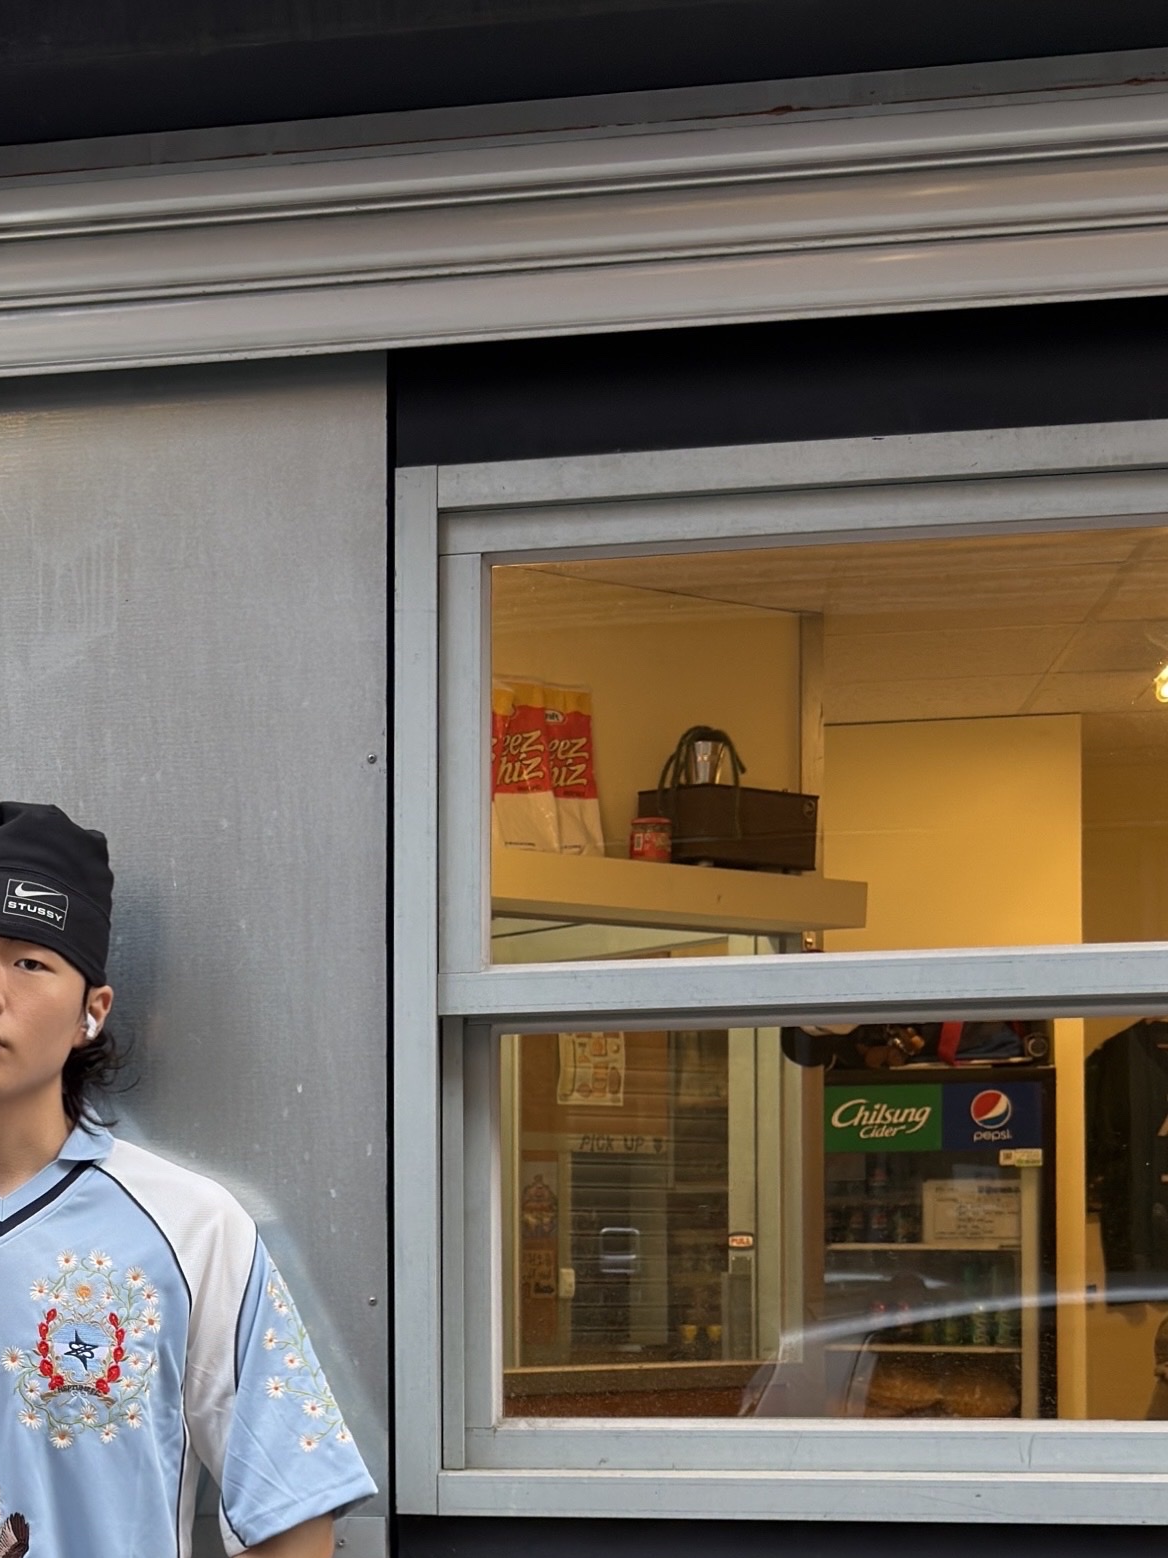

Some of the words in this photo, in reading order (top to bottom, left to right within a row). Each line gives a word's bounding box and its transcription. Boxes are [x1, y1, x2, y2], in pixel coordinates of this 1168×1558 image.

[8, 901, 63, 922] STUSSY
[832, 1099, 931, 1134] Chilsung
[973, 1130, 1011, 1143] pepsi
[859, 1124, 906, 1139] Cider
[579, 1134, 614, 1152] PICK
[623, 1135, 644, 1152] UP
